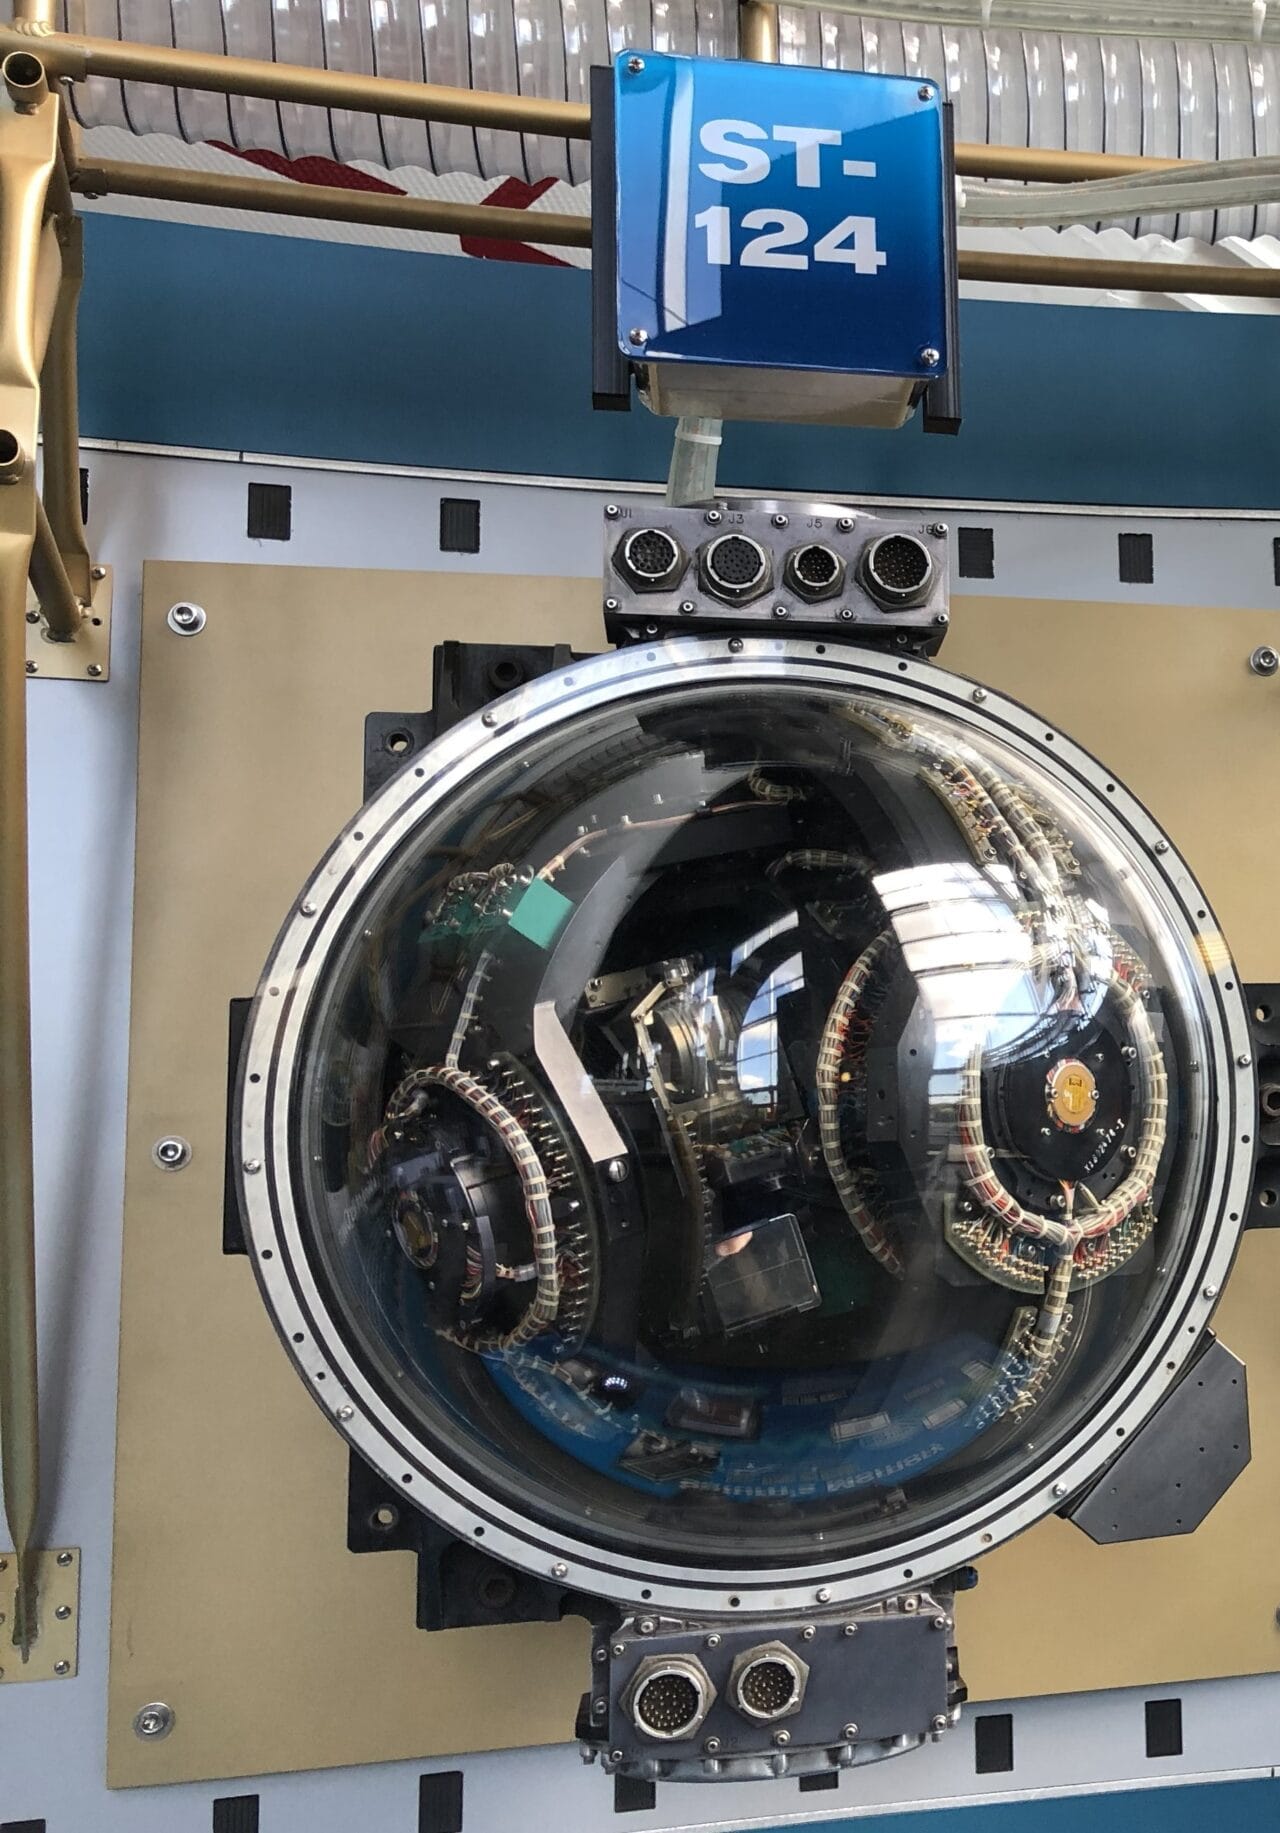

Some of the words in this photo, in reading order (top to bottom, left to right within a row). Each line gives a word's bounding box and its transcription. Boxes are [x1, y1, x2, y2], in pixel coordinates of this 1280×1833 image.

[698, 119, 877, 189] ST-
[694, 206, 887, 276] 124
[727, 513, 745, 524] J3
[806, 518, 823, 529] J5
